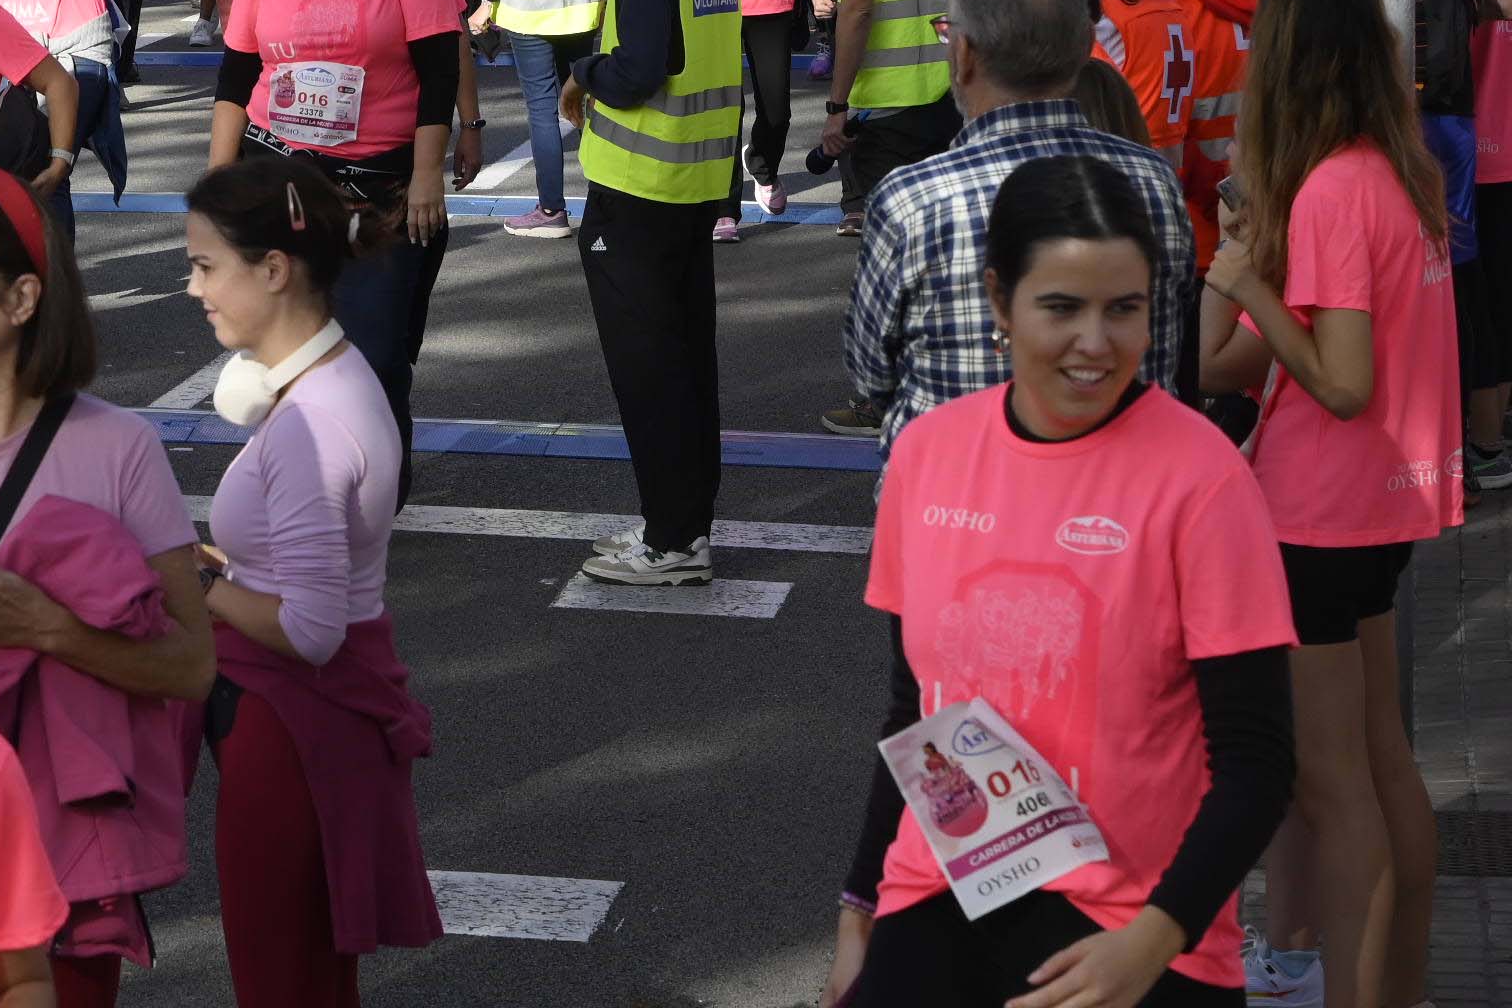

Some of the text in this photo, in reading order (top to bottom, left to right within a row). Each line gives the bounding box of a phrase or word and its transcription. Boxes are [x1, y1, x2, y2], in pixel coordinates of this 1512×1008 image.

[268, 41, 297, 60] TU
[299, 71, 333, 85] ASTURIANA
[298, 91, 329, 107] 016
[276, 114, 300, 124] CARRERA
[299, 107, 324, 118] 23378
[1476, 142, 1499, 154] SHO
[923, 504, 997, 534] OYSHO
[969, 834, 1025, 867] CARRERA
[1026, 825, 1045, 839] DE
[977, 856, 1042, 897] OYSHO
